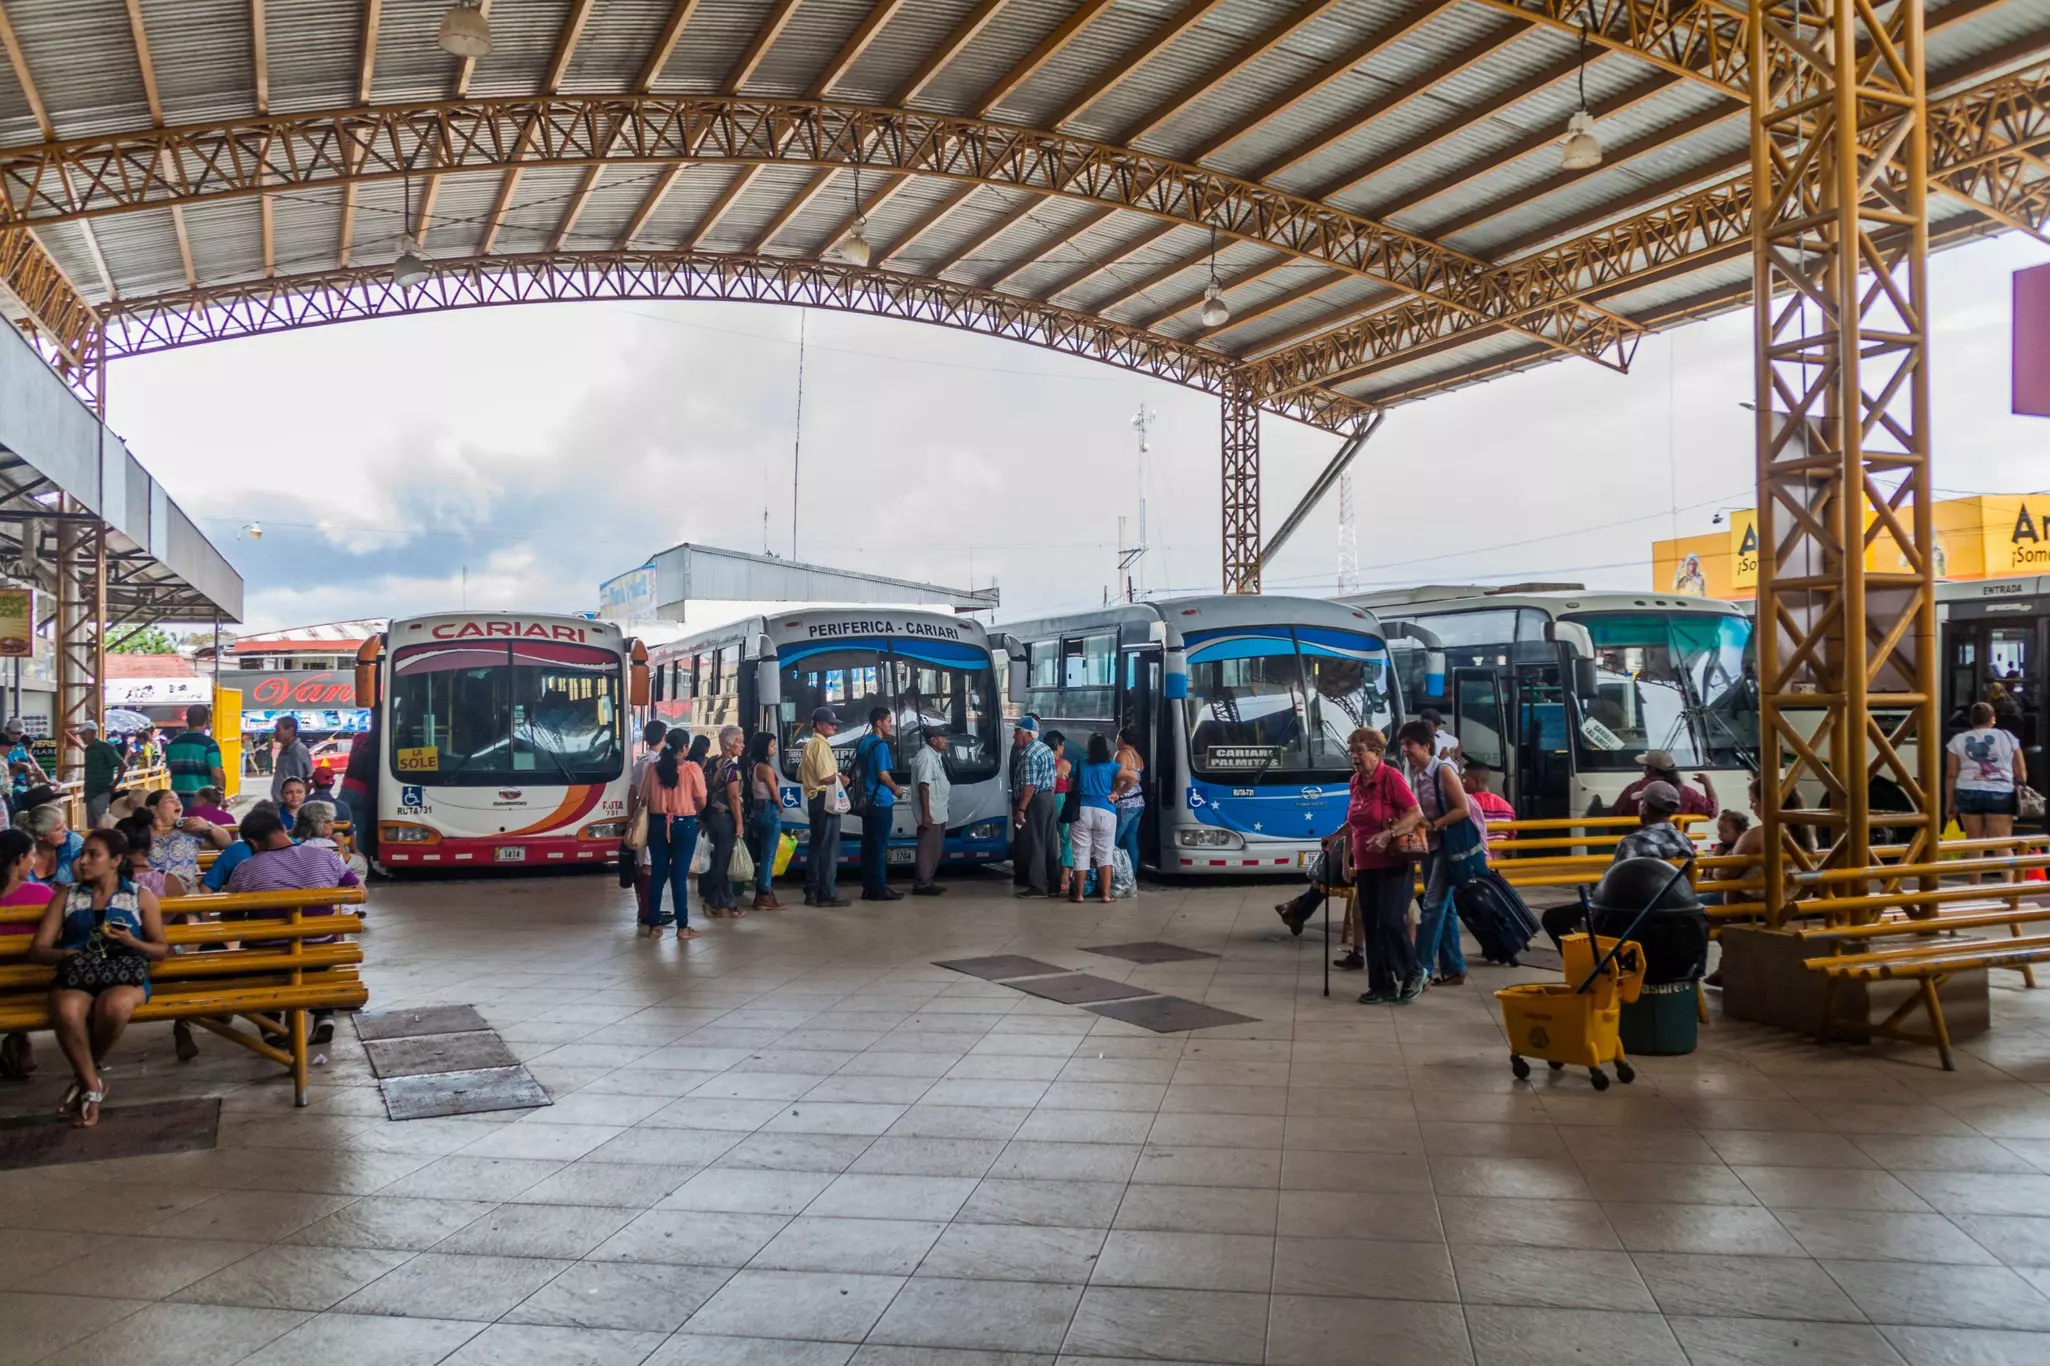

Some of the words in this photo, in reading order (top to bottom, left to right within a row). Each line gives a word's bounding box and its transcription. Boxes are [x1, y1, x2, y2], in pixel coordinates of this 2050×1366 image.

[1738, 522, 1758, 556] A
[2012, 546, 2050, 568] ¡Som
[1737, 558, 1757, 576] ¡So
[1983, 584, 2023, 595] ENTRADA
[432, 621, 585, 643] CARIARI
[808, 620, 895, 638] PERIFERICA
[905, 622, 960, 640] CARIARI
[253, 672, 356, 706] Van
[1216, 749, 1273, 757] CARIARI
[400, 756, 437, 769] SOLE
[1211, 758, 1279, 767] PALMITS
[504, 849, 520, 858] 1414
[1641, 981, 1690, 995] asurero
